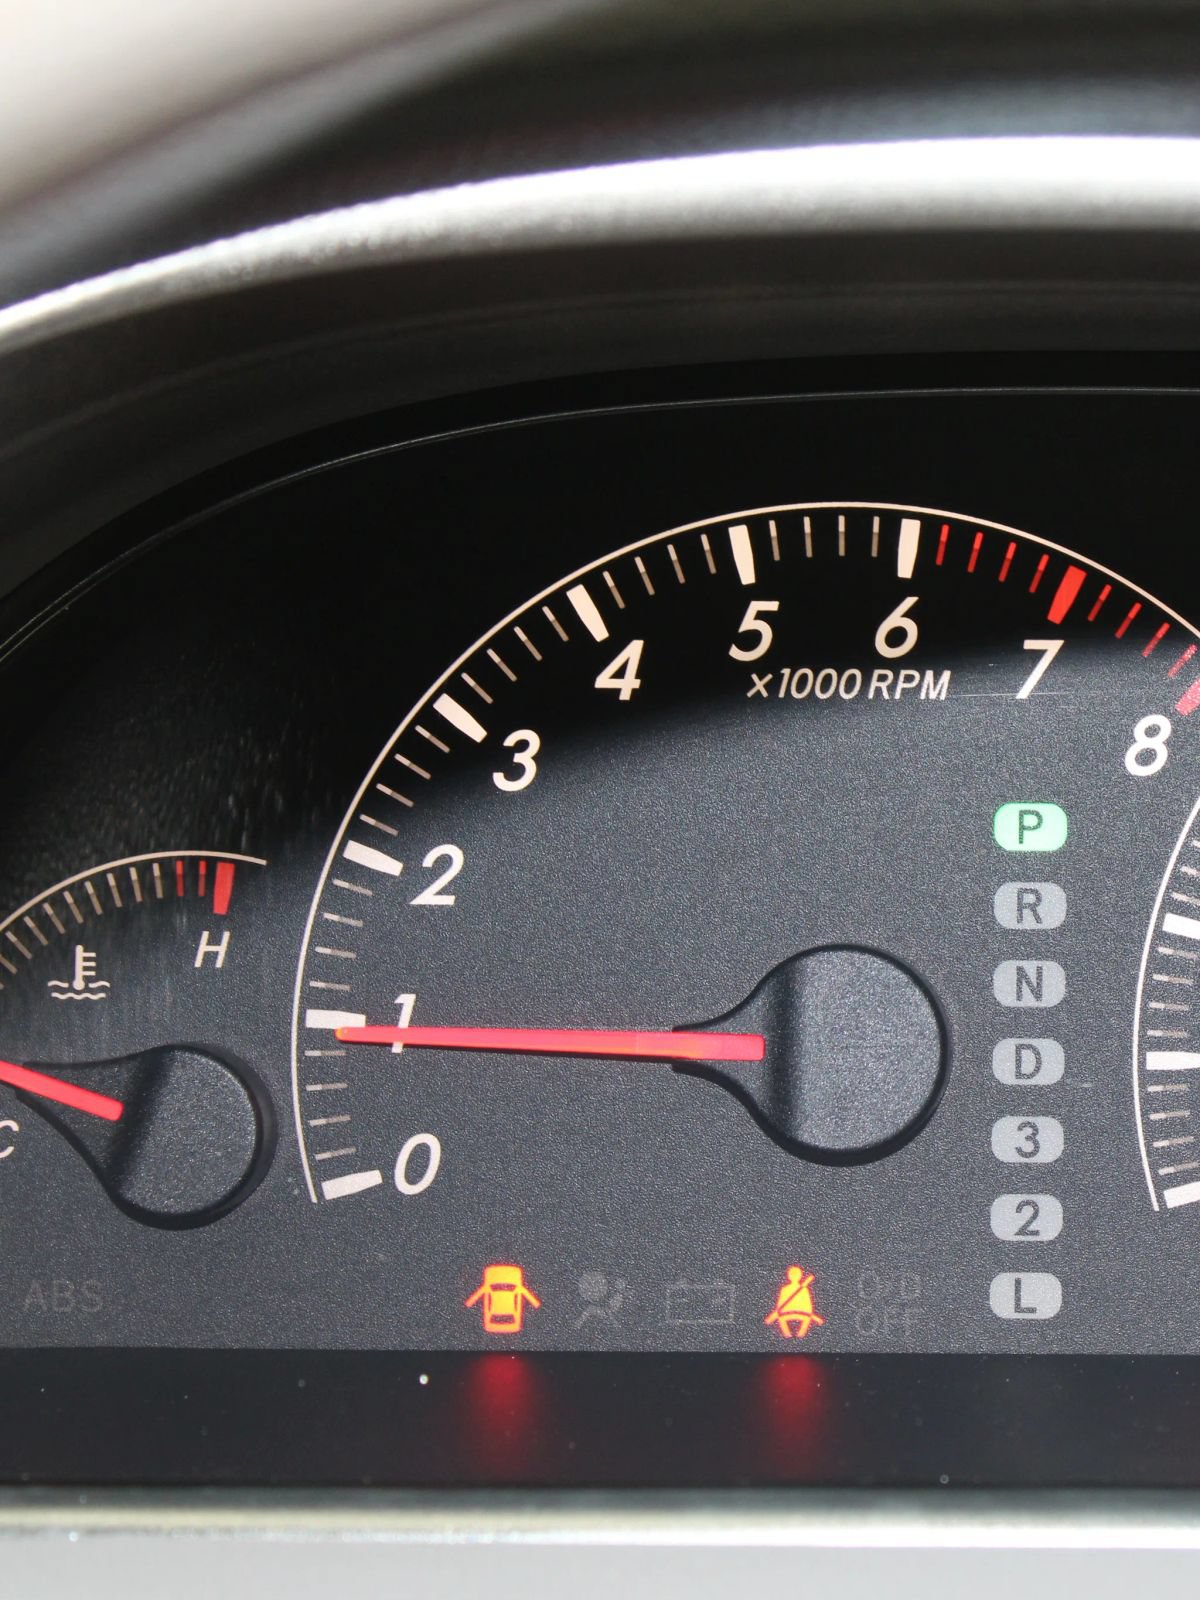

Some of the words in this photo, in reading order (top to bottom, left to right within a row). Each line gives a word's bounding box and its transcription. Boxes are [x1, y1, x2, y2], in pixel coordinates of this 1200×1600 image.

[728, 600, 780, 662] 5
[874, 596, 919, 659] 6
[594, 639, 644, 701] 4
[868, 669, 951, 701] RPM
[1015, 640, 1062, 700] 7
[492, 729, 540, 792] 3
[1124, 714, 1172, 777] 8
[1018, 809, 1043, 844] P
[410, 844, 464, 906] 2
[1016, 887, 1042, 924] R
[194, 930, 230, 969] H
[1016, 965, 1043, 1002] N
[391, 993, 417, 1054] 1
[1015, 1043, 1042, 1080] D
[1015, 1121, 1041, 1158] 3
[394, 1133, 441, 1195] 0
[1014, 1200, 1040, 1236] 2
[23, 1279, 104, 1313] ABS
[1014, 1277, 1037, 1314] L
